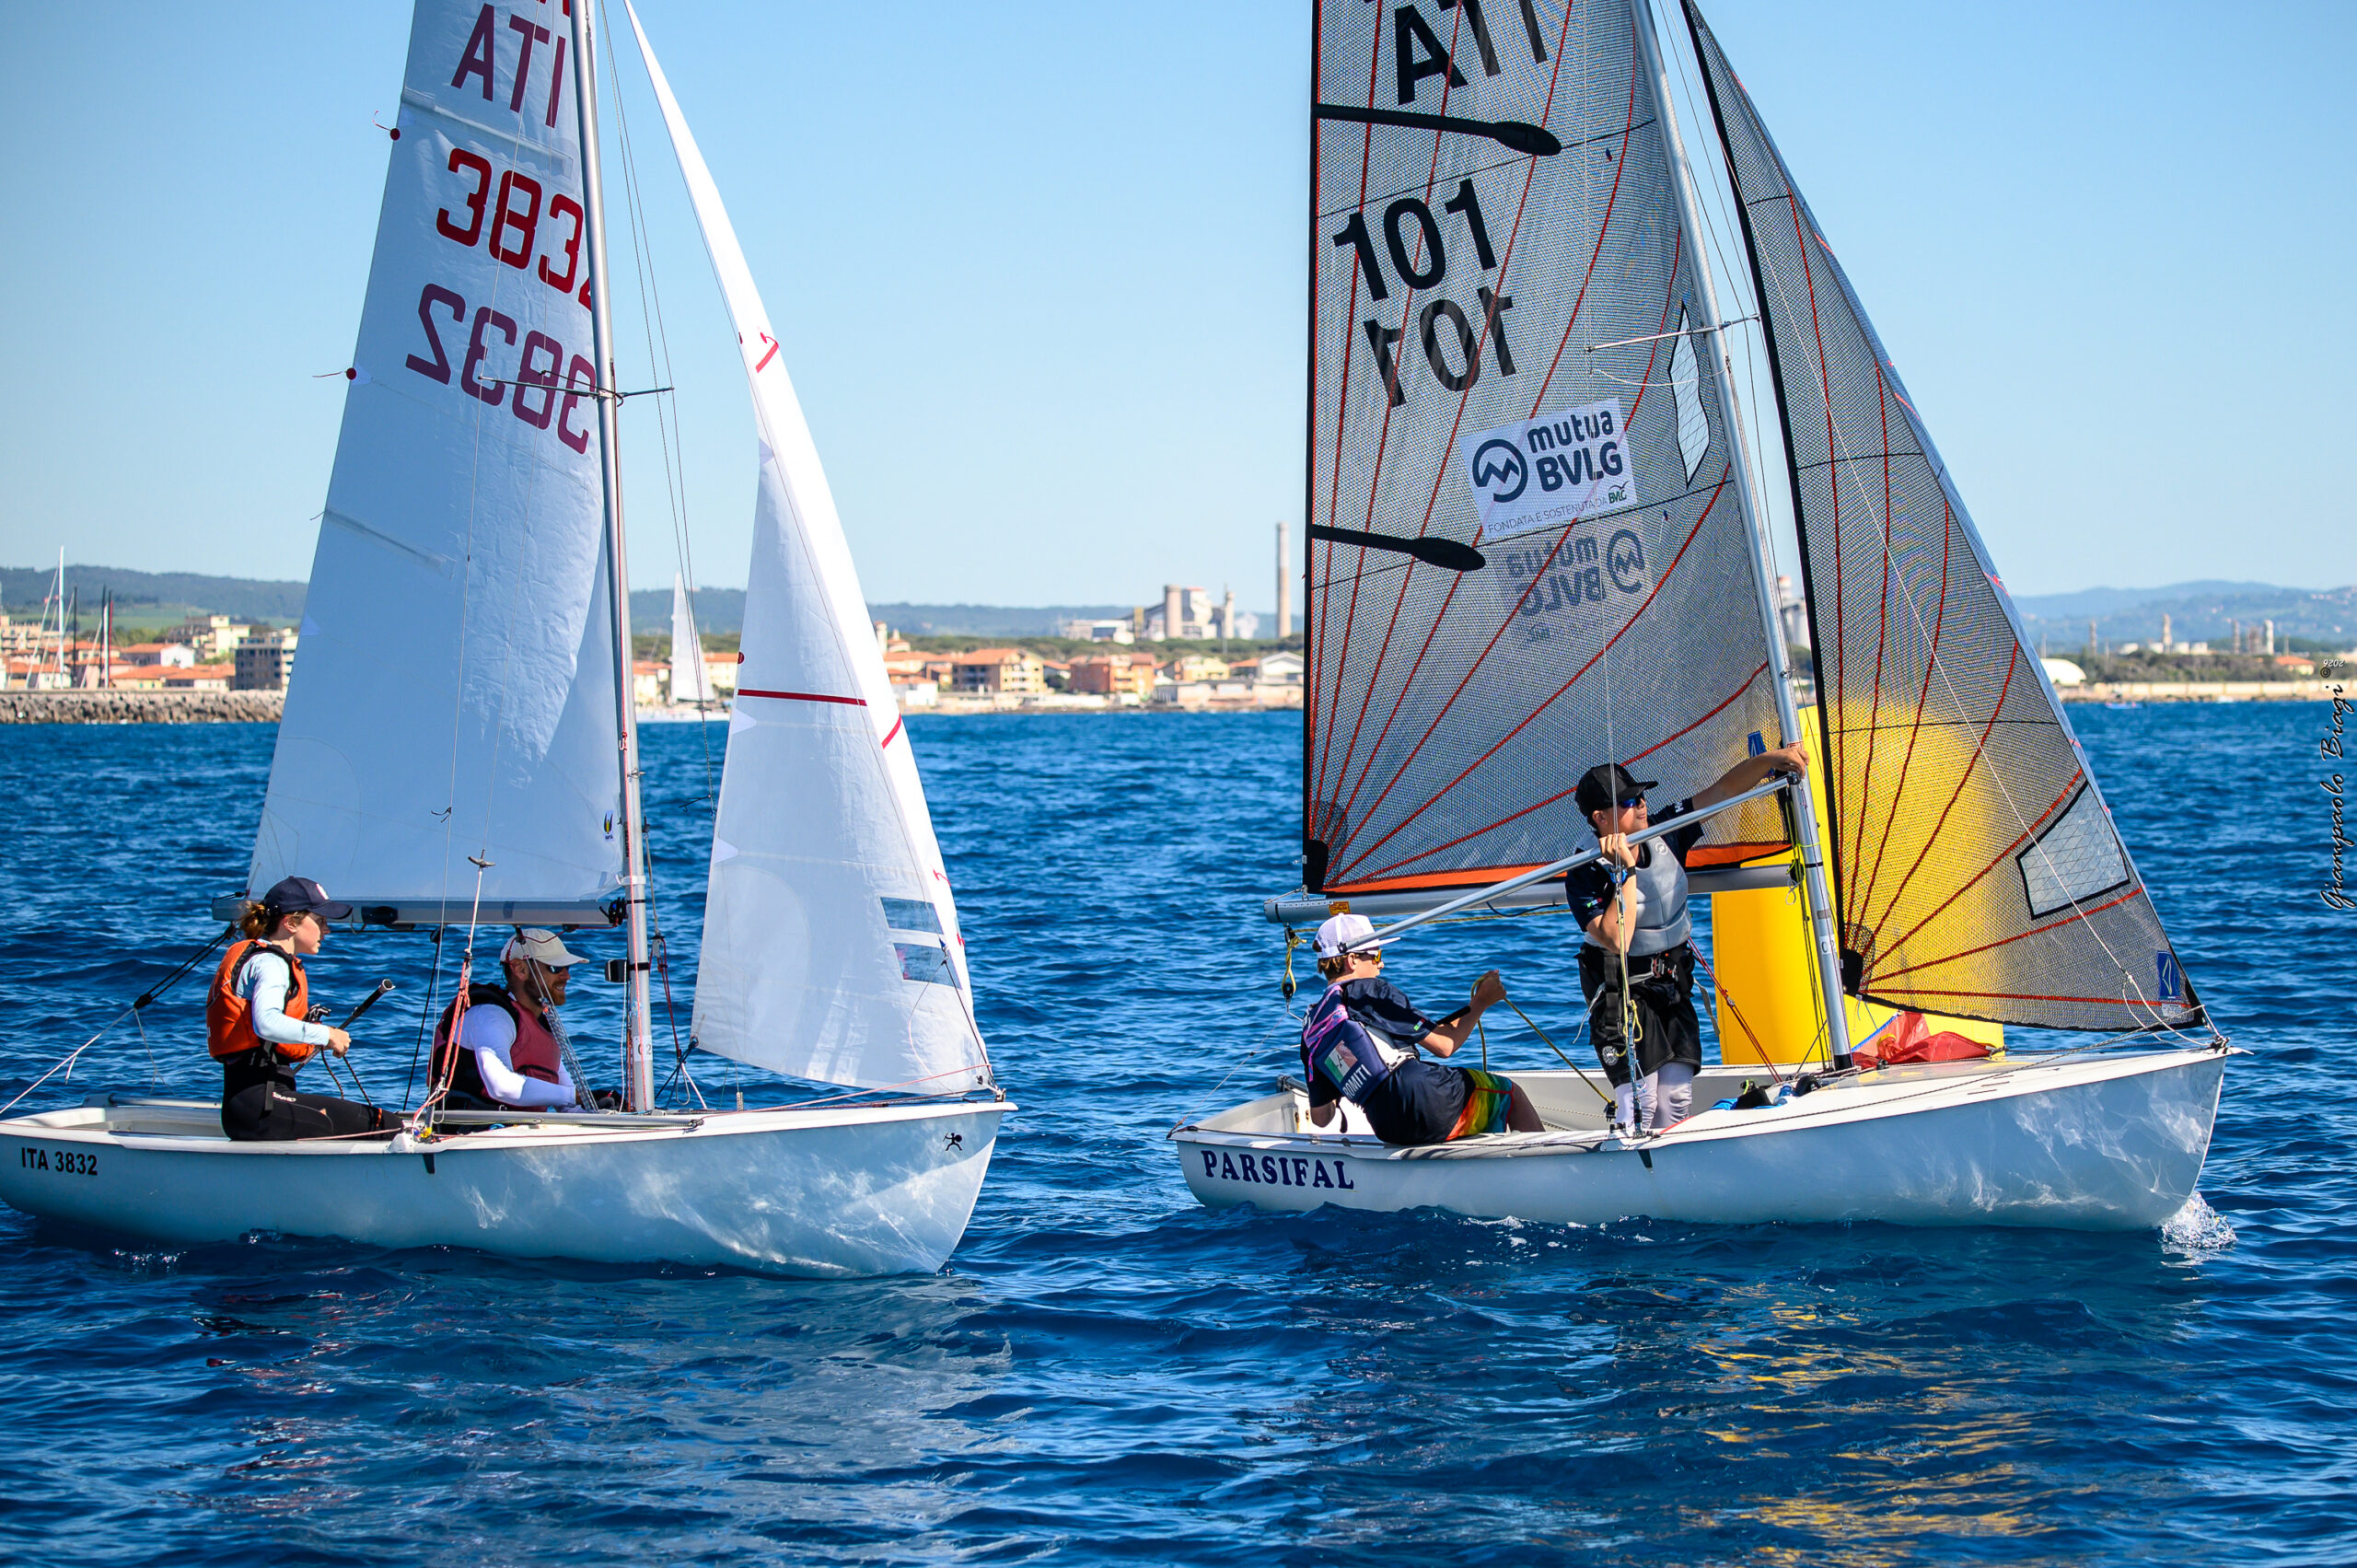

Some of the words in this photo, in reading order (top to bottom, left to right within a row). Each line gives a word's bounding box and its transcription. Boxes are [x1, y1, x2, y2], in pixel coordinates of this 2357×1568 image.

[1332, 177, 1497, 302] 101
[1527, 411, 1614, 454] mutua
[1536, 441, 1623, 493] BVLG
[1487, 515, 1534, 533] FONDATA
[1535, 512, 1542, 522] E
[1543, 500, 1595, 519] SOSTENUTA
[1342, 1064, 1372, 1099] ROMITI
[21, 1146, 50, 1170] ITA
[54, 1150, 98, 1176] 3832
[1200, 1149, 1355, 1190] PARSIFAL
